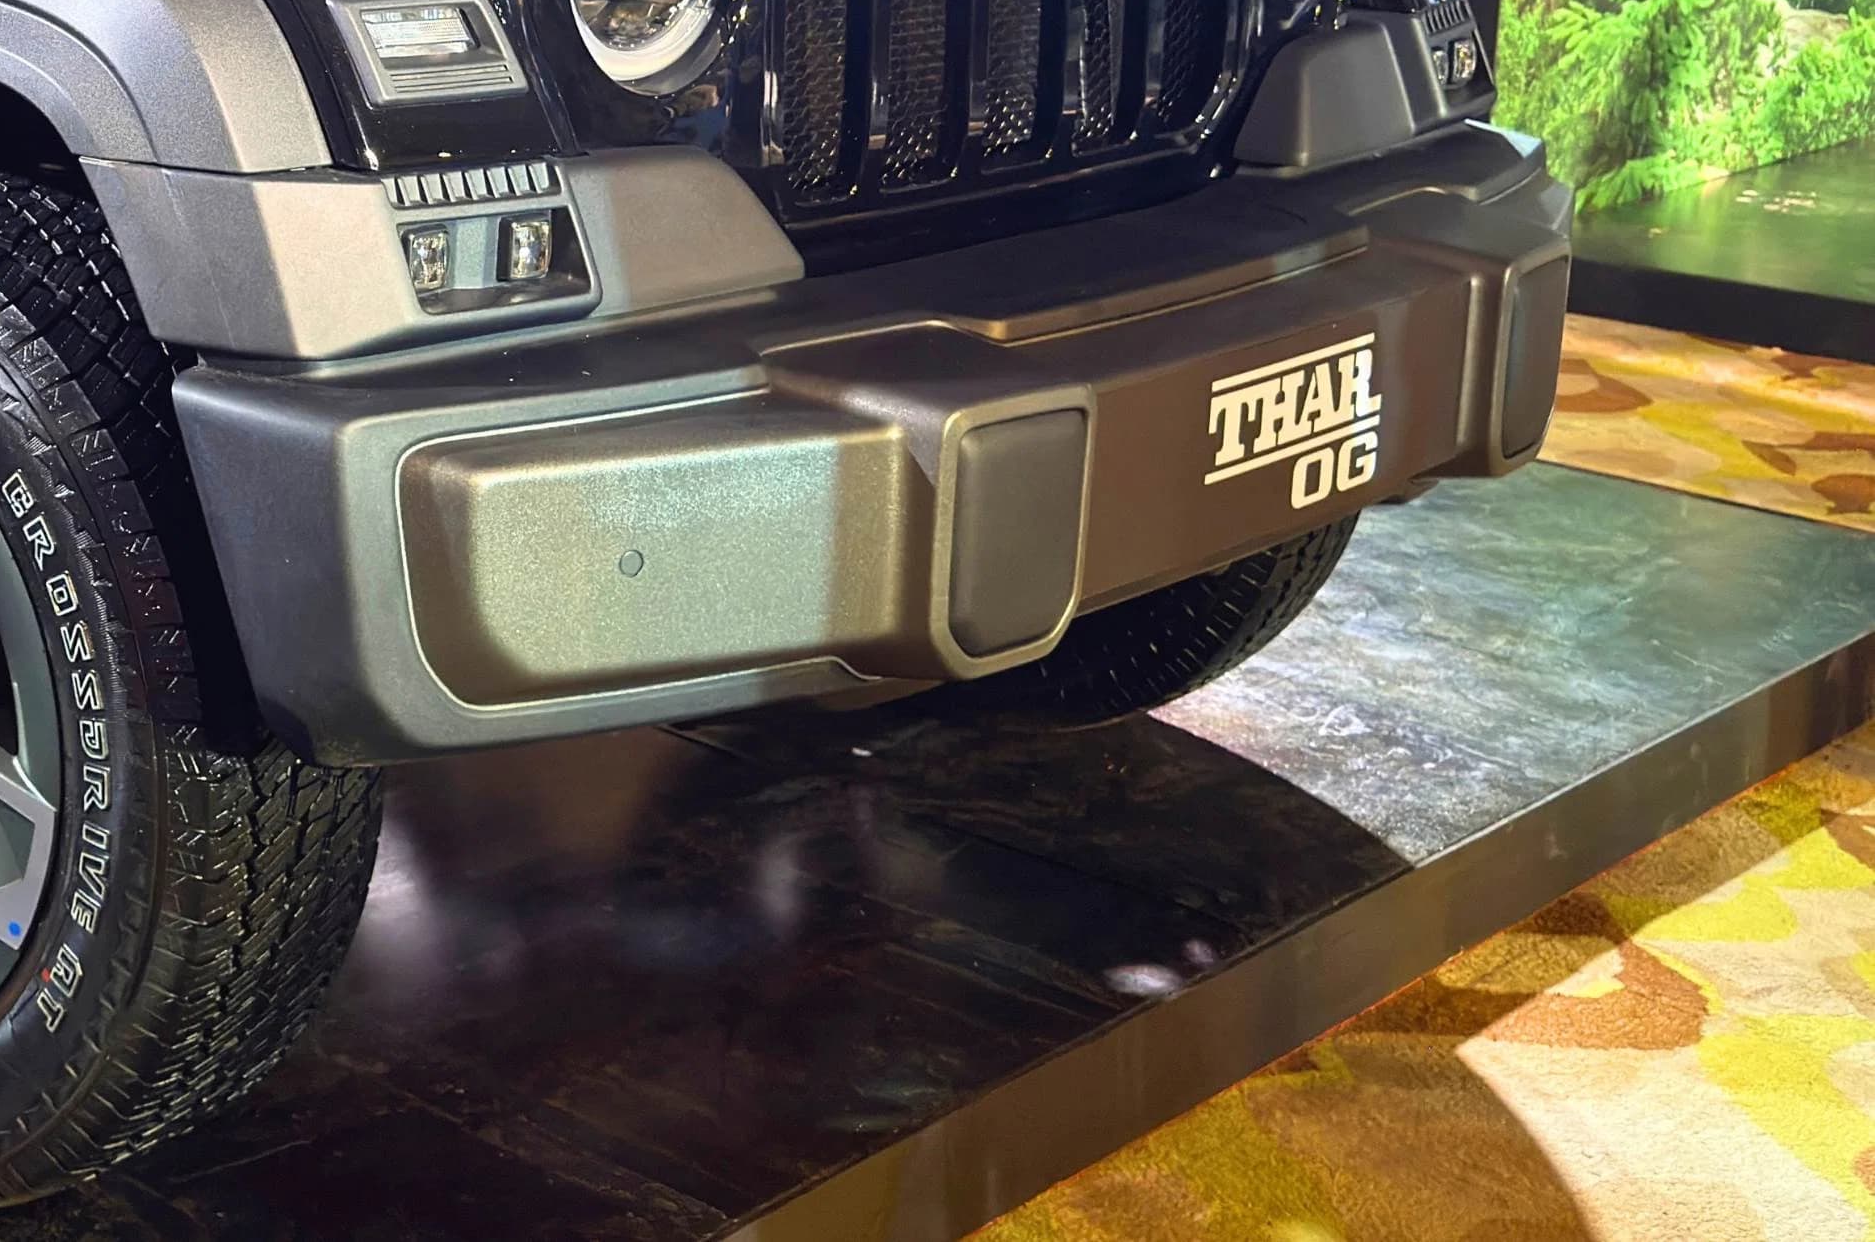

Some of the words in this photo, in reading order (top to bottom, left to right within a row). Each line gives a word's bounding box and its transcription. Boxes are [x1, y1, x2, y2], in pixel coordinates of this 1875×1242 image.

[1208, 349, 1382, 466] THAR
[1291, 431, 1378, 509] OG
[2, 469, 111, 934] CROSSDRIVE
